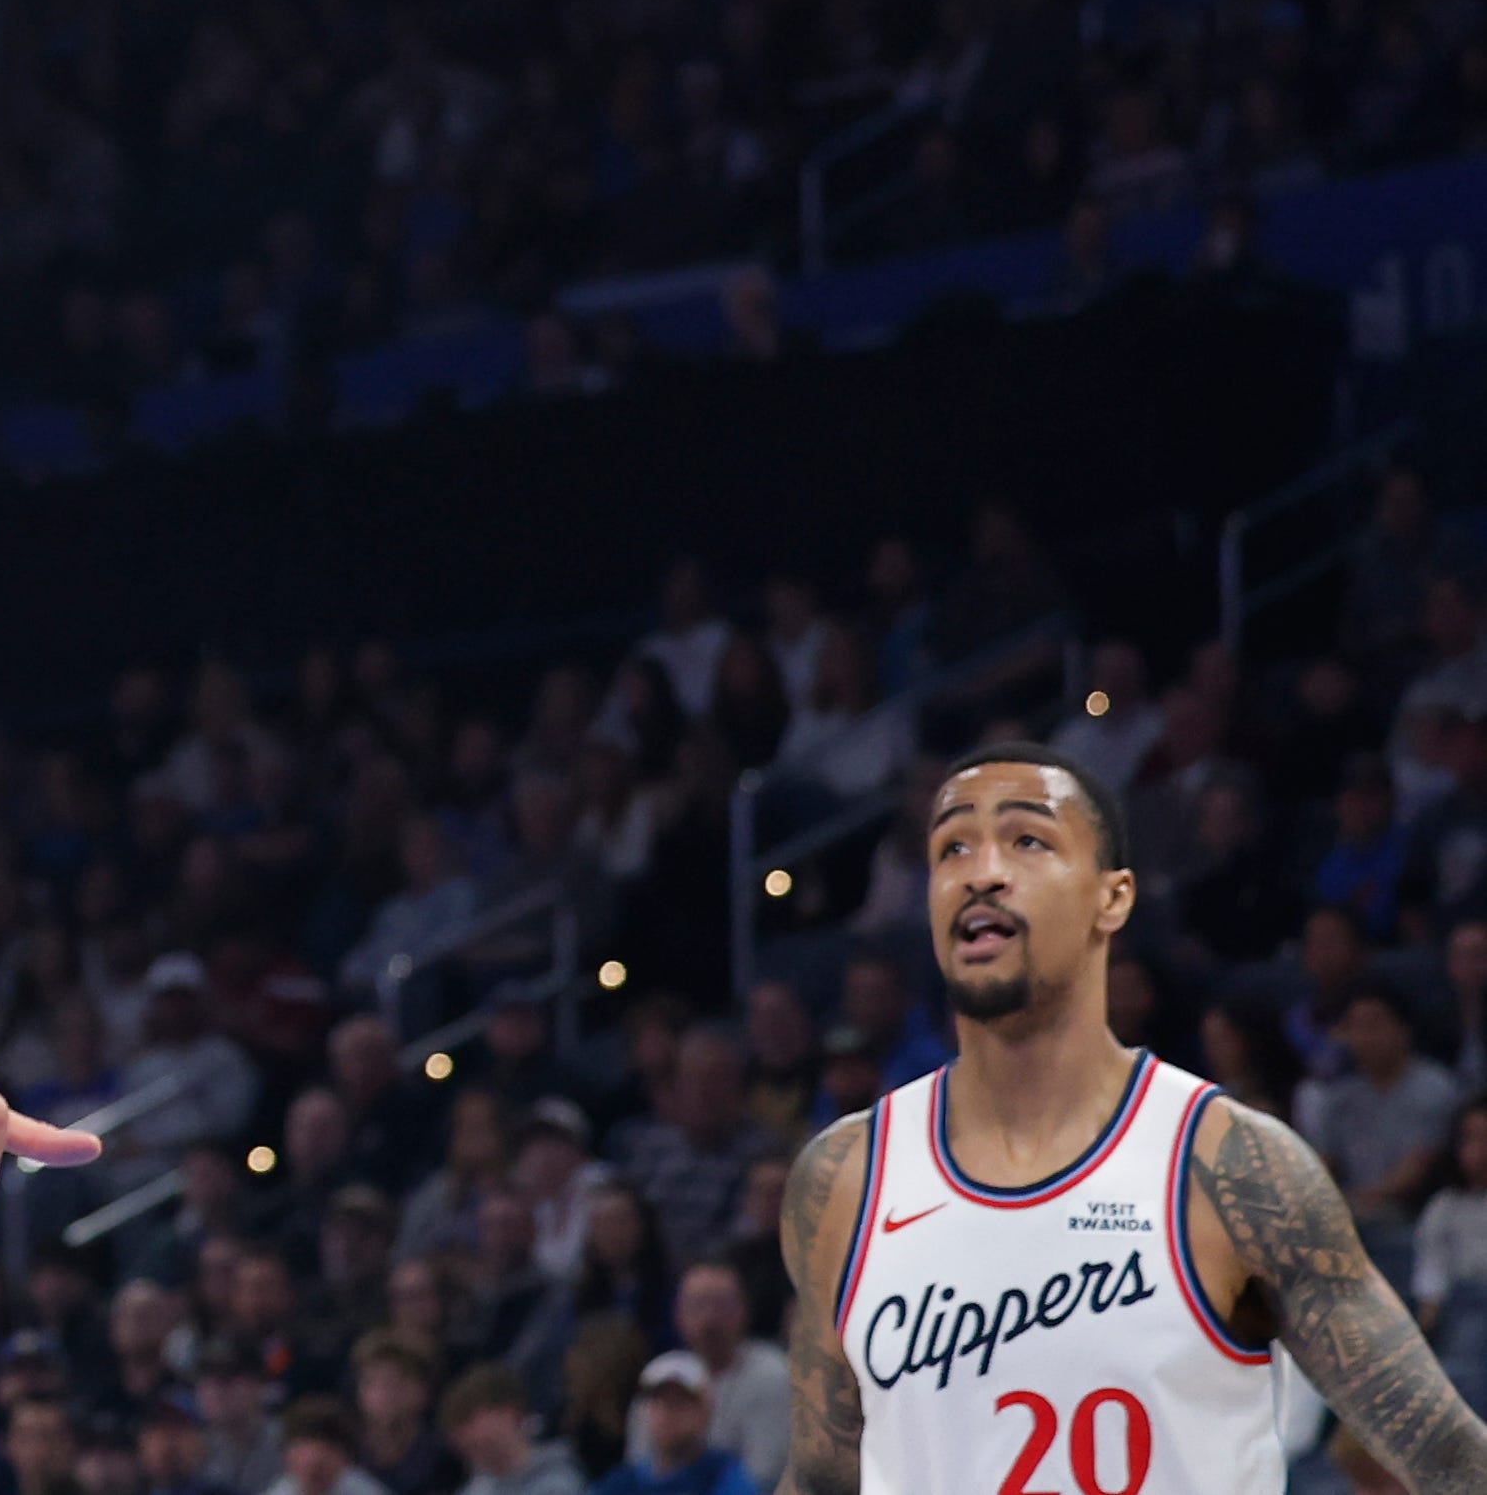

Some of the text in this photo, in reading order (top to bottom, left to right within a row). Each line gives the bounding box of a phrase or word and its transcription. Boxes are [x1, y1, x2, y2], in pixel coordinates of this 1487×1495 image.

[1068, 1217, 1153, 1232] RWANDA
[1087, 1202, 1136, 1215] VISIT
[864, 1250, 1157, 1391] Clippers
[994, 1387, 1153, 1495] 20
